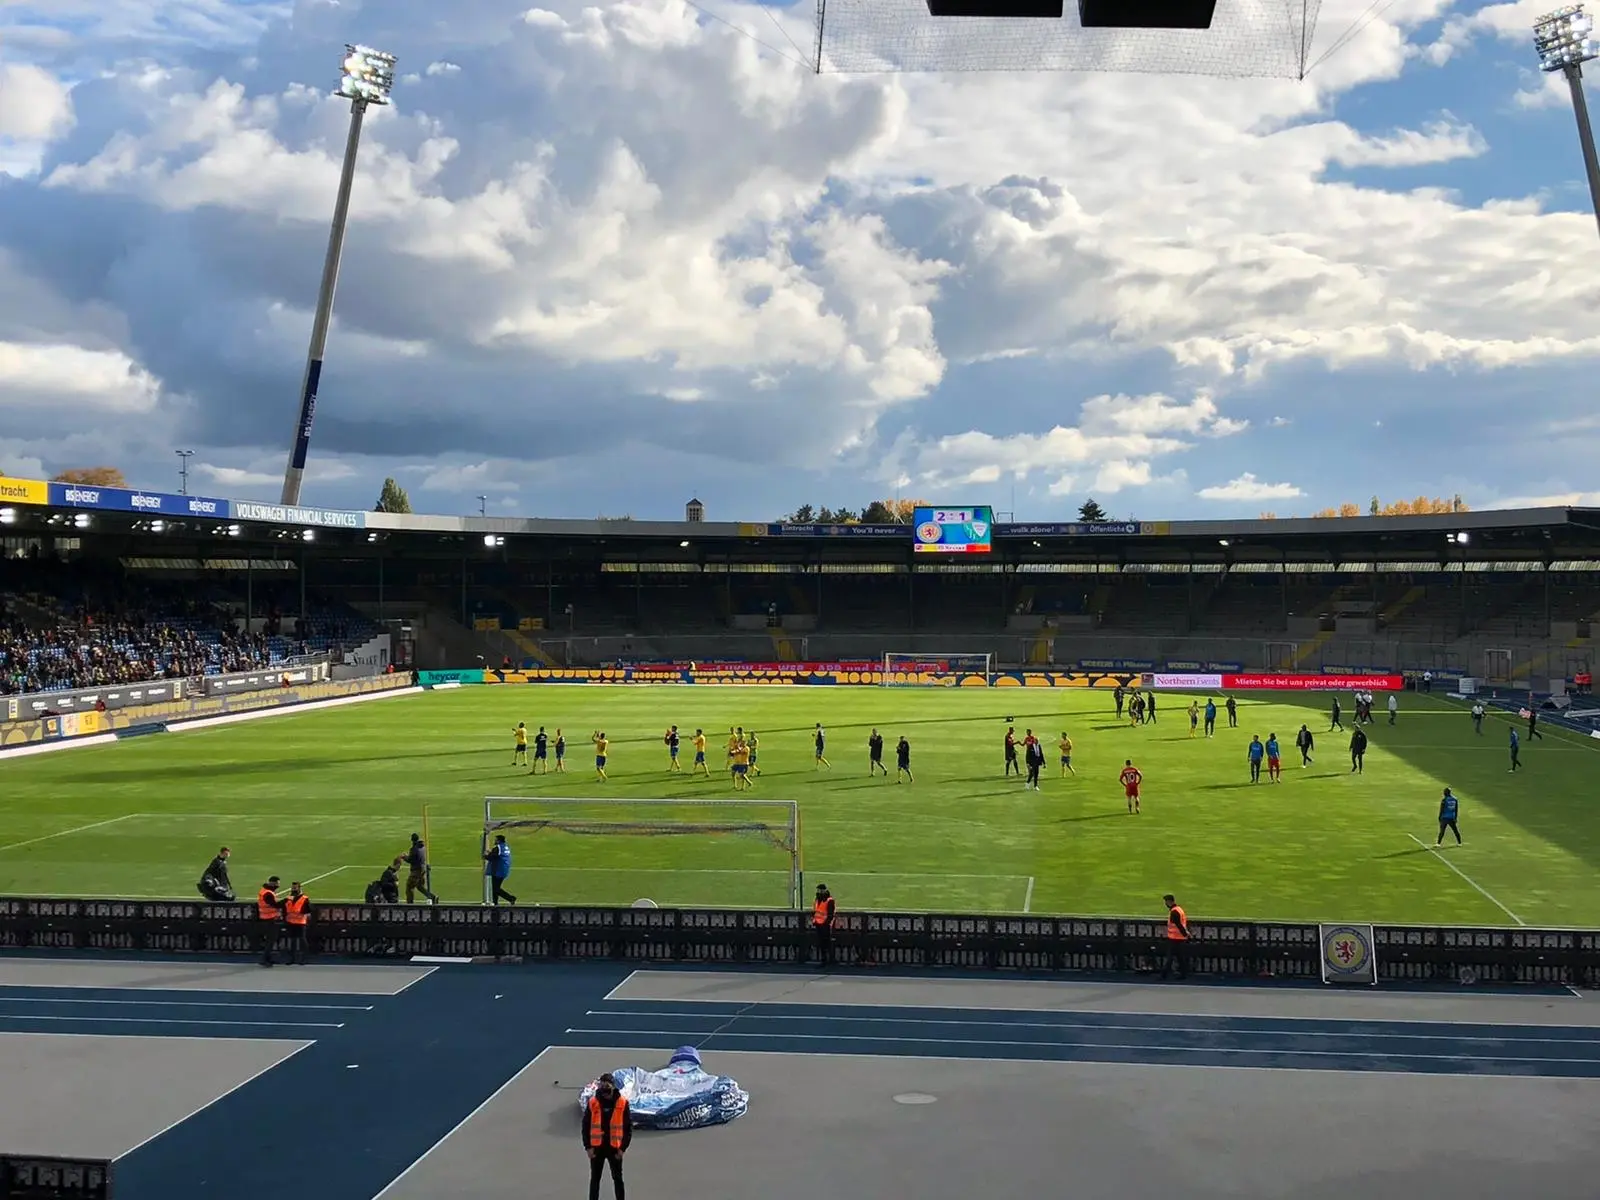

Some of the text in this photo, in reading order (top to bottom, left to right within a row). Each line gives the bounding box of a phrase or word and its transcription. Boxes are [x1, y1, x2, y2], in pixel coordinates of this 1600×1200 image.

[236, 503, 357, 526] VOLKSWAGEN FINANCIAL SERVICES
[937, 512, 966, 521] 2 1
[428, 672, 461, 682] heycar
[1157, 676, 1195, 685] Northern
[1276, 678, 1288, 686] bei
[1305, 679, 1327, 688] privat
[1328, 679, 1345, 687] oder
[1346, 679, 1388, 689] gewerblich
[1126, 773, 1135, 783] 10
